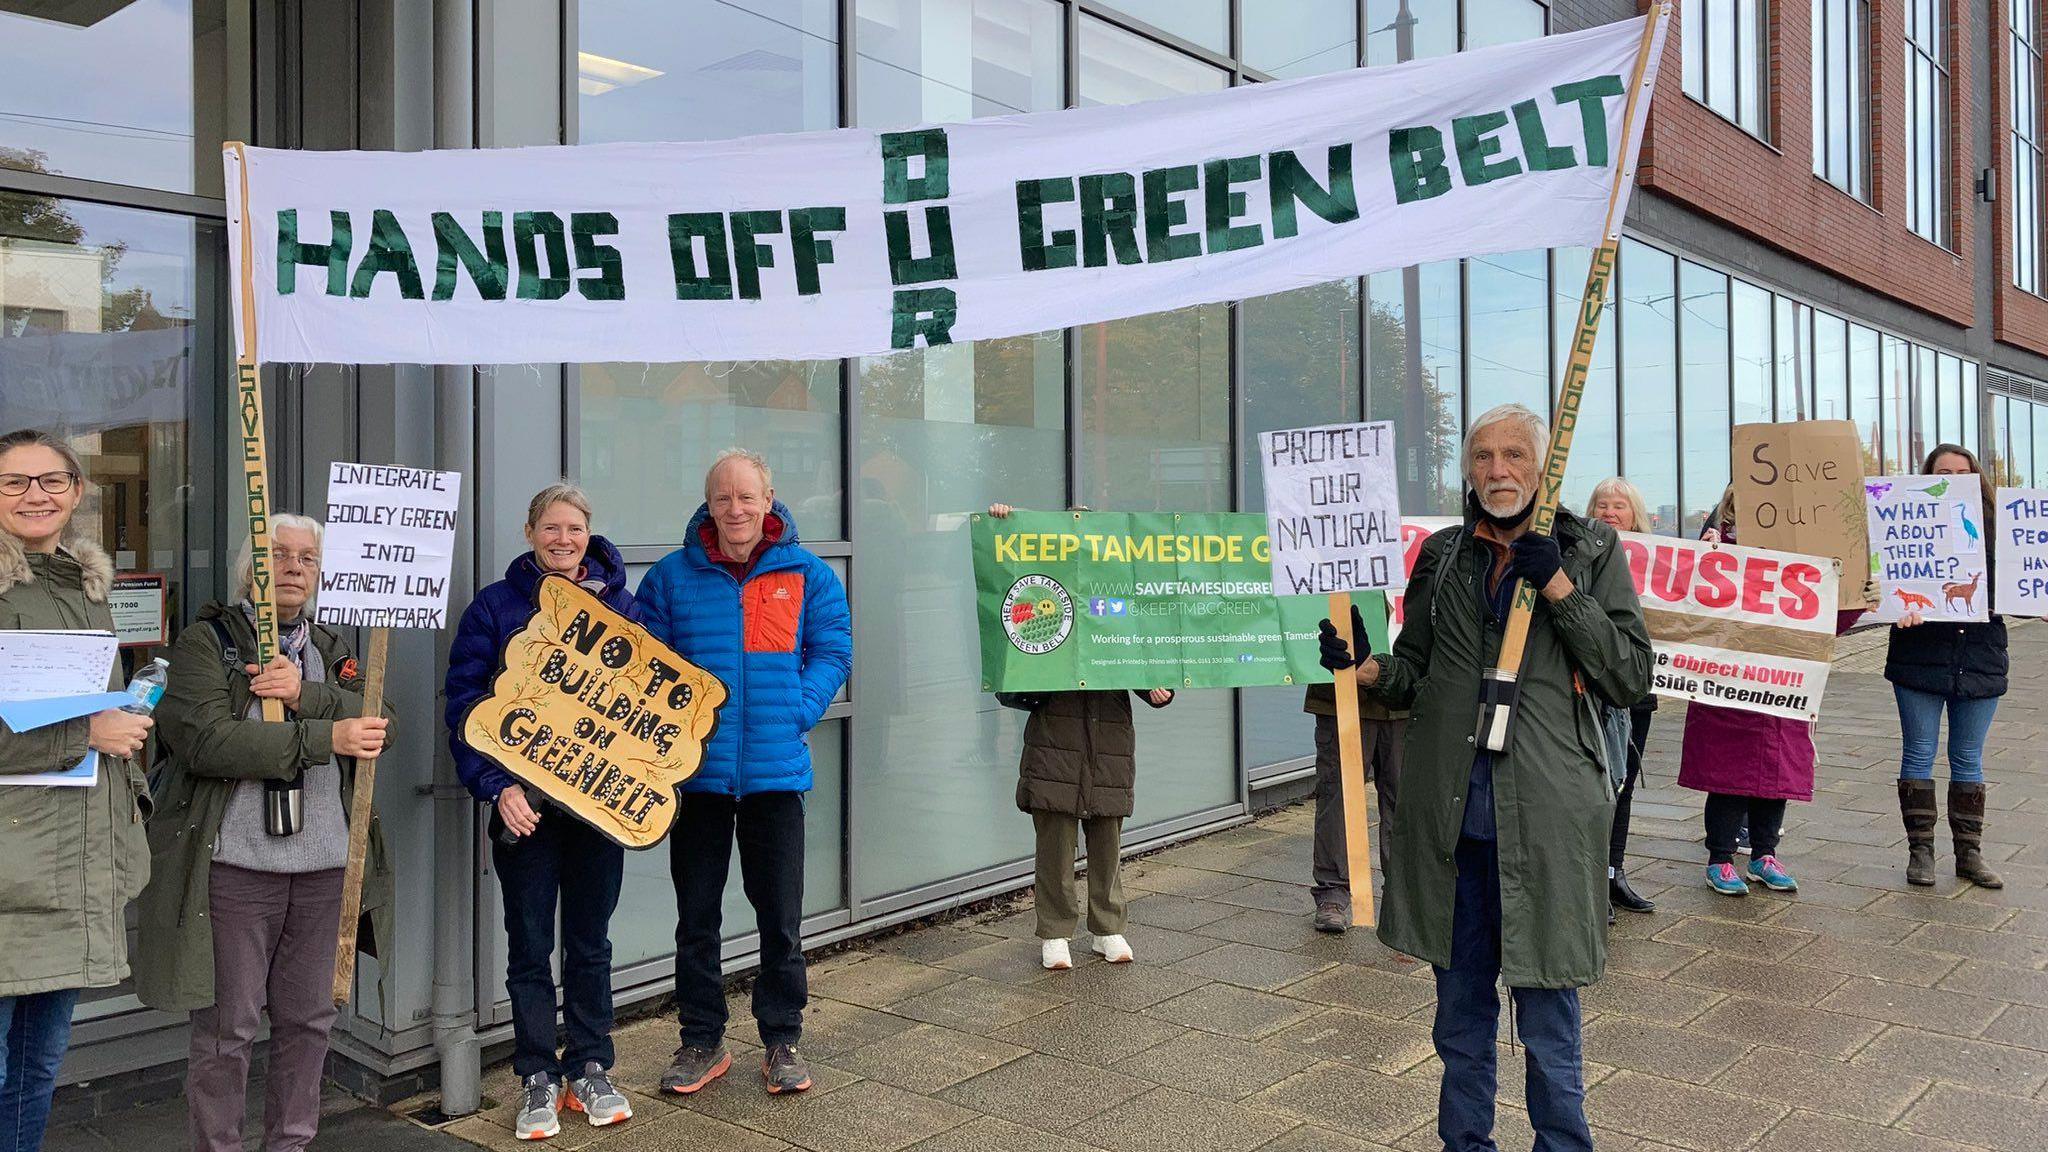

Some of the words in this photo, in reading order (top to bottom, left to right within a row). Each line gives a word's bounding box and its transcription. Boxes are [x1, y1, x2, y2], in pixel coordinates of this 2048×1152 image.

[277, 209, 625, 300] HANDS
[668, 207, 846, 300] OFF
[881, 128, 958, 349] OUR
[1016, 143, 1360, 271] GREEN
[1389, 75, 1624, 204] BELT
[1577, 248, 1615, 354] SAVE
[239, 364, 259, 460] SAVE
[1271, 425, 1386, 466] PROTECT
[1545, 364, 1587, 504] GODLEY
[333, 464, 447, 491] INTEGRATE
[1750, 443, 1837, 485] Save
[1310, 473, 1360, 505] OUR
[326, 504, 397, 525] GODLEY
[401, 507, 456, 530] GREEN
[1875, 502, 1939, 521] WHAT
[2006, 498, 2048, 520] THE
[246, 471, 269, 601] GODLEY
[1277, 511, 1397, 551] NATURAL
[1886, 524, 1947, 540] ABOUT
[2012, 528, 2048, 546] PEO
[361, 543, 415, 563] INTO
[994, 533, 1080, 563] KEEP
[1084, 535, 1244, 563] TAMESIDE
[1884, 543, 1935, 560] THEIR
[1286, 555, 1389, 594] WORLD
[1886, 557, 1959, 580] HOME?
[321, 572, 396, 594] WERNETH
[404, 575, 445, 598] LOW
[1003, 594, 1014, 621] HELP
[1014, 577, 1036, 592] SAVE
[1040, 577, 1072, 620] TAMESIDE
[1129, 602, 1261, 616] @KEEPTMBCGREEN
[1010, 632, 1038, 652] GREEN
[1043, 632, 1064, 651] BELT
[1091, 633, 1130, 645] Working
[1133, 634, 1145, 643] for
[1155, 635, 1205, 646] prosperous
[1207, 632, 1256, 642] sustainable
[1258, 634, 1282, 644] green
[560, 609, 632, 669] NO
[644, 657, 692, 710] TO
[1673, 653, 1741, 678] Object
[1742, 665, 1804, 688] NOW!!
[1703, 679, 1808, 710] Greenbelt!
[574, 717, 617, 750] ON
[500, 708, 668, 825] GREENBELT
